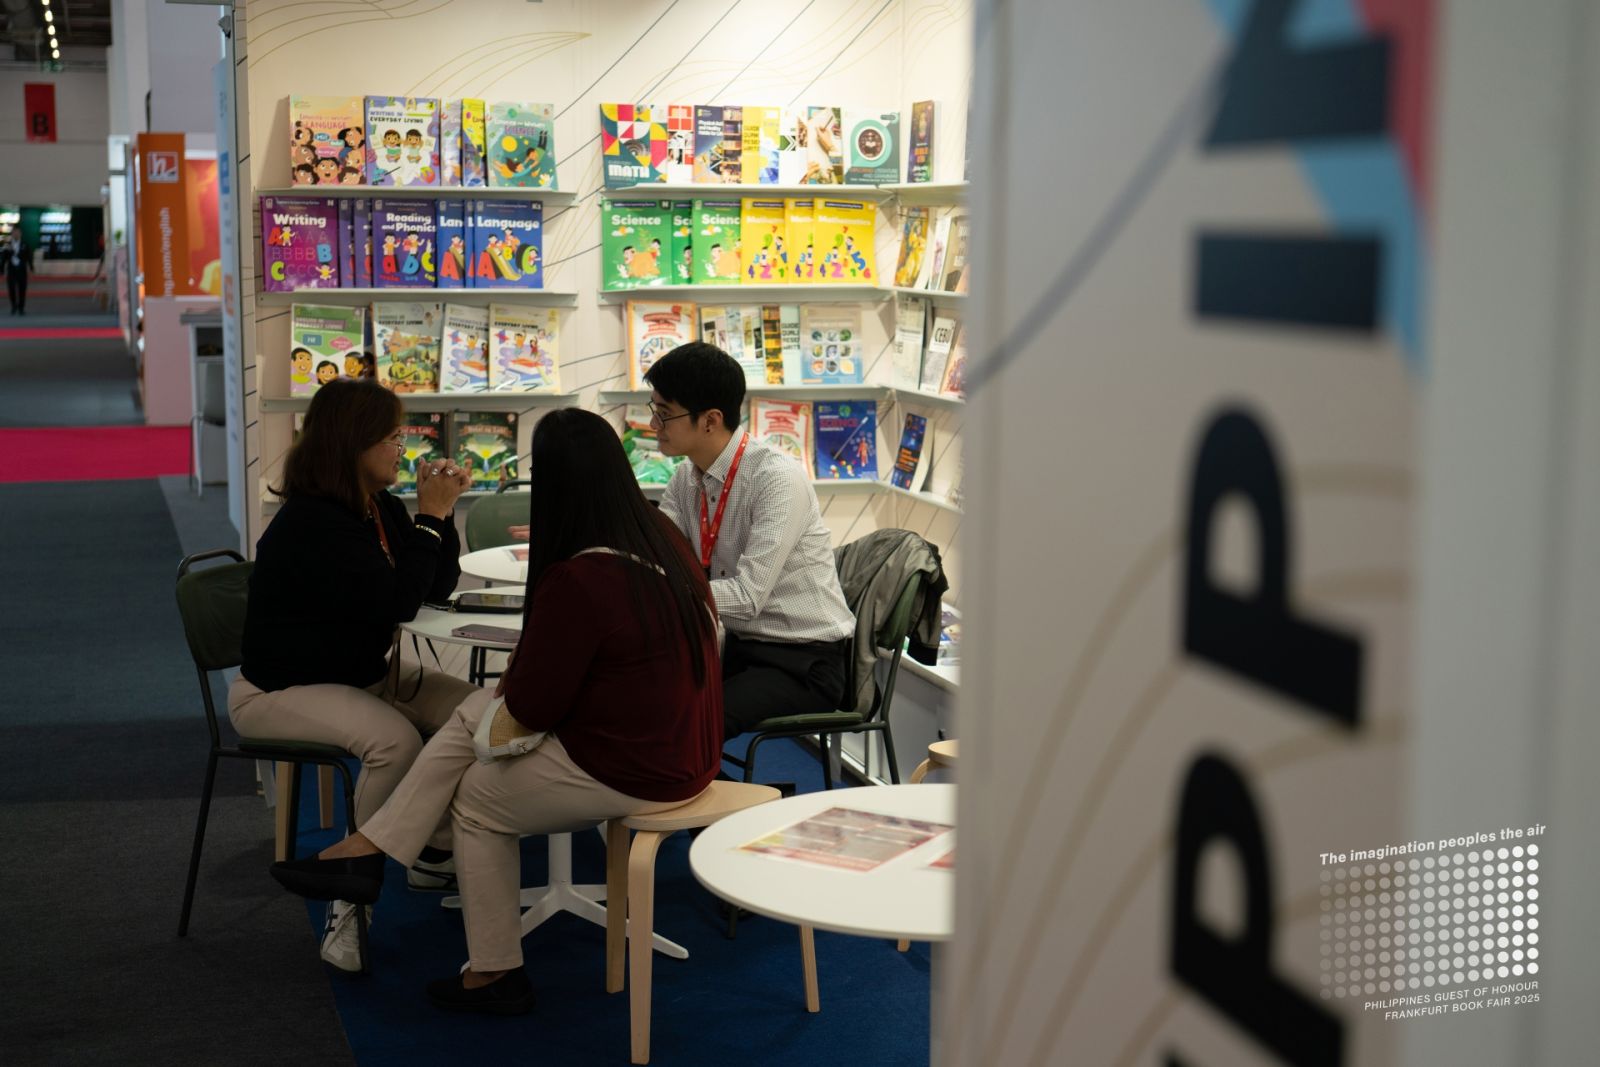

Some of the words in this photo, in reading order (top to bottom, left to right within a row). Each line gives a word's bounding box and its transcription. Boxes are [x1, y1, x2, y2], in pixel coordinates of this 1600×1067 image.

[33, 112, 49, 136] B
[272, 213, 327, 229] Writing
[386, 212, 432, 225] Reading
[477, 215, 540, 231] Language
[611, 214, 662, 226] Science
